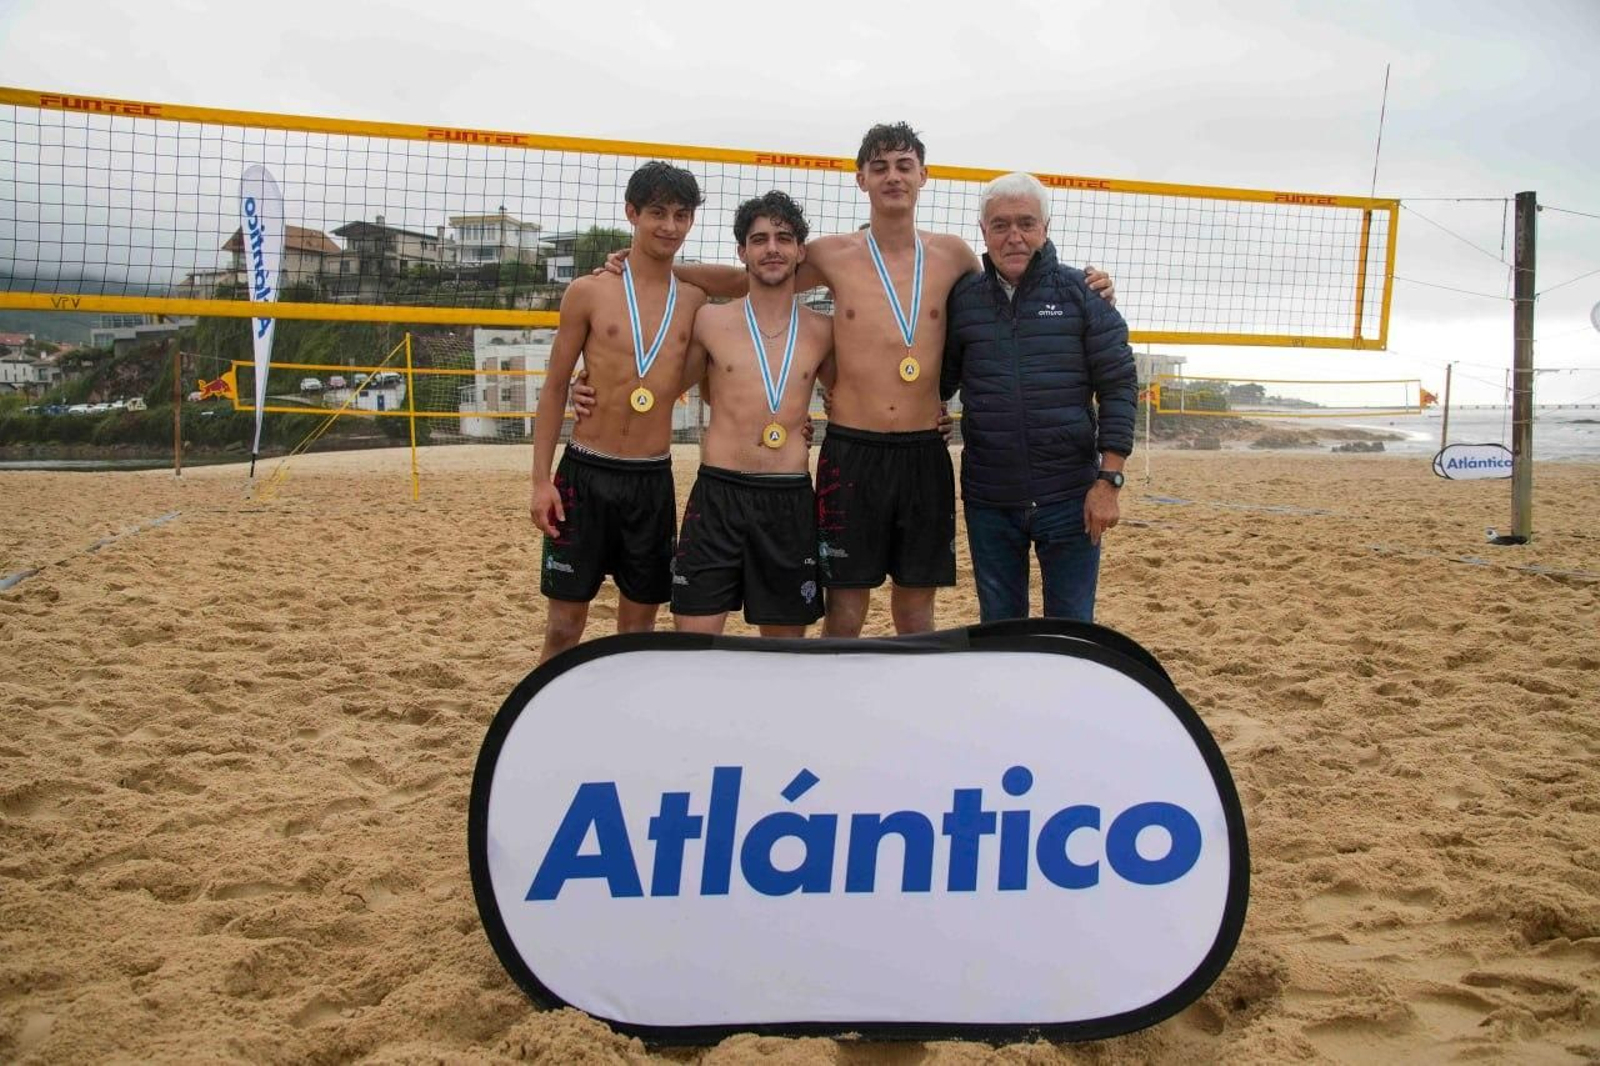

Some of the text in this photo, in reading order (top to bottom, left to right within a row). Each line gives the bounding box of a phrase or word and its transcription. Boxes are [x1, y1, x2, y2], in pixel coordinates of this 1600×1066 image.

[39, 95, 162, 116] FUNTEC
[427, 129, 529, 146] FUNTEC
[756, 154, 843, 169] FUNTEC
[1274, 193, 1337, 206] FUNTEC
[523, 765, 1202, 901] Atlántico
